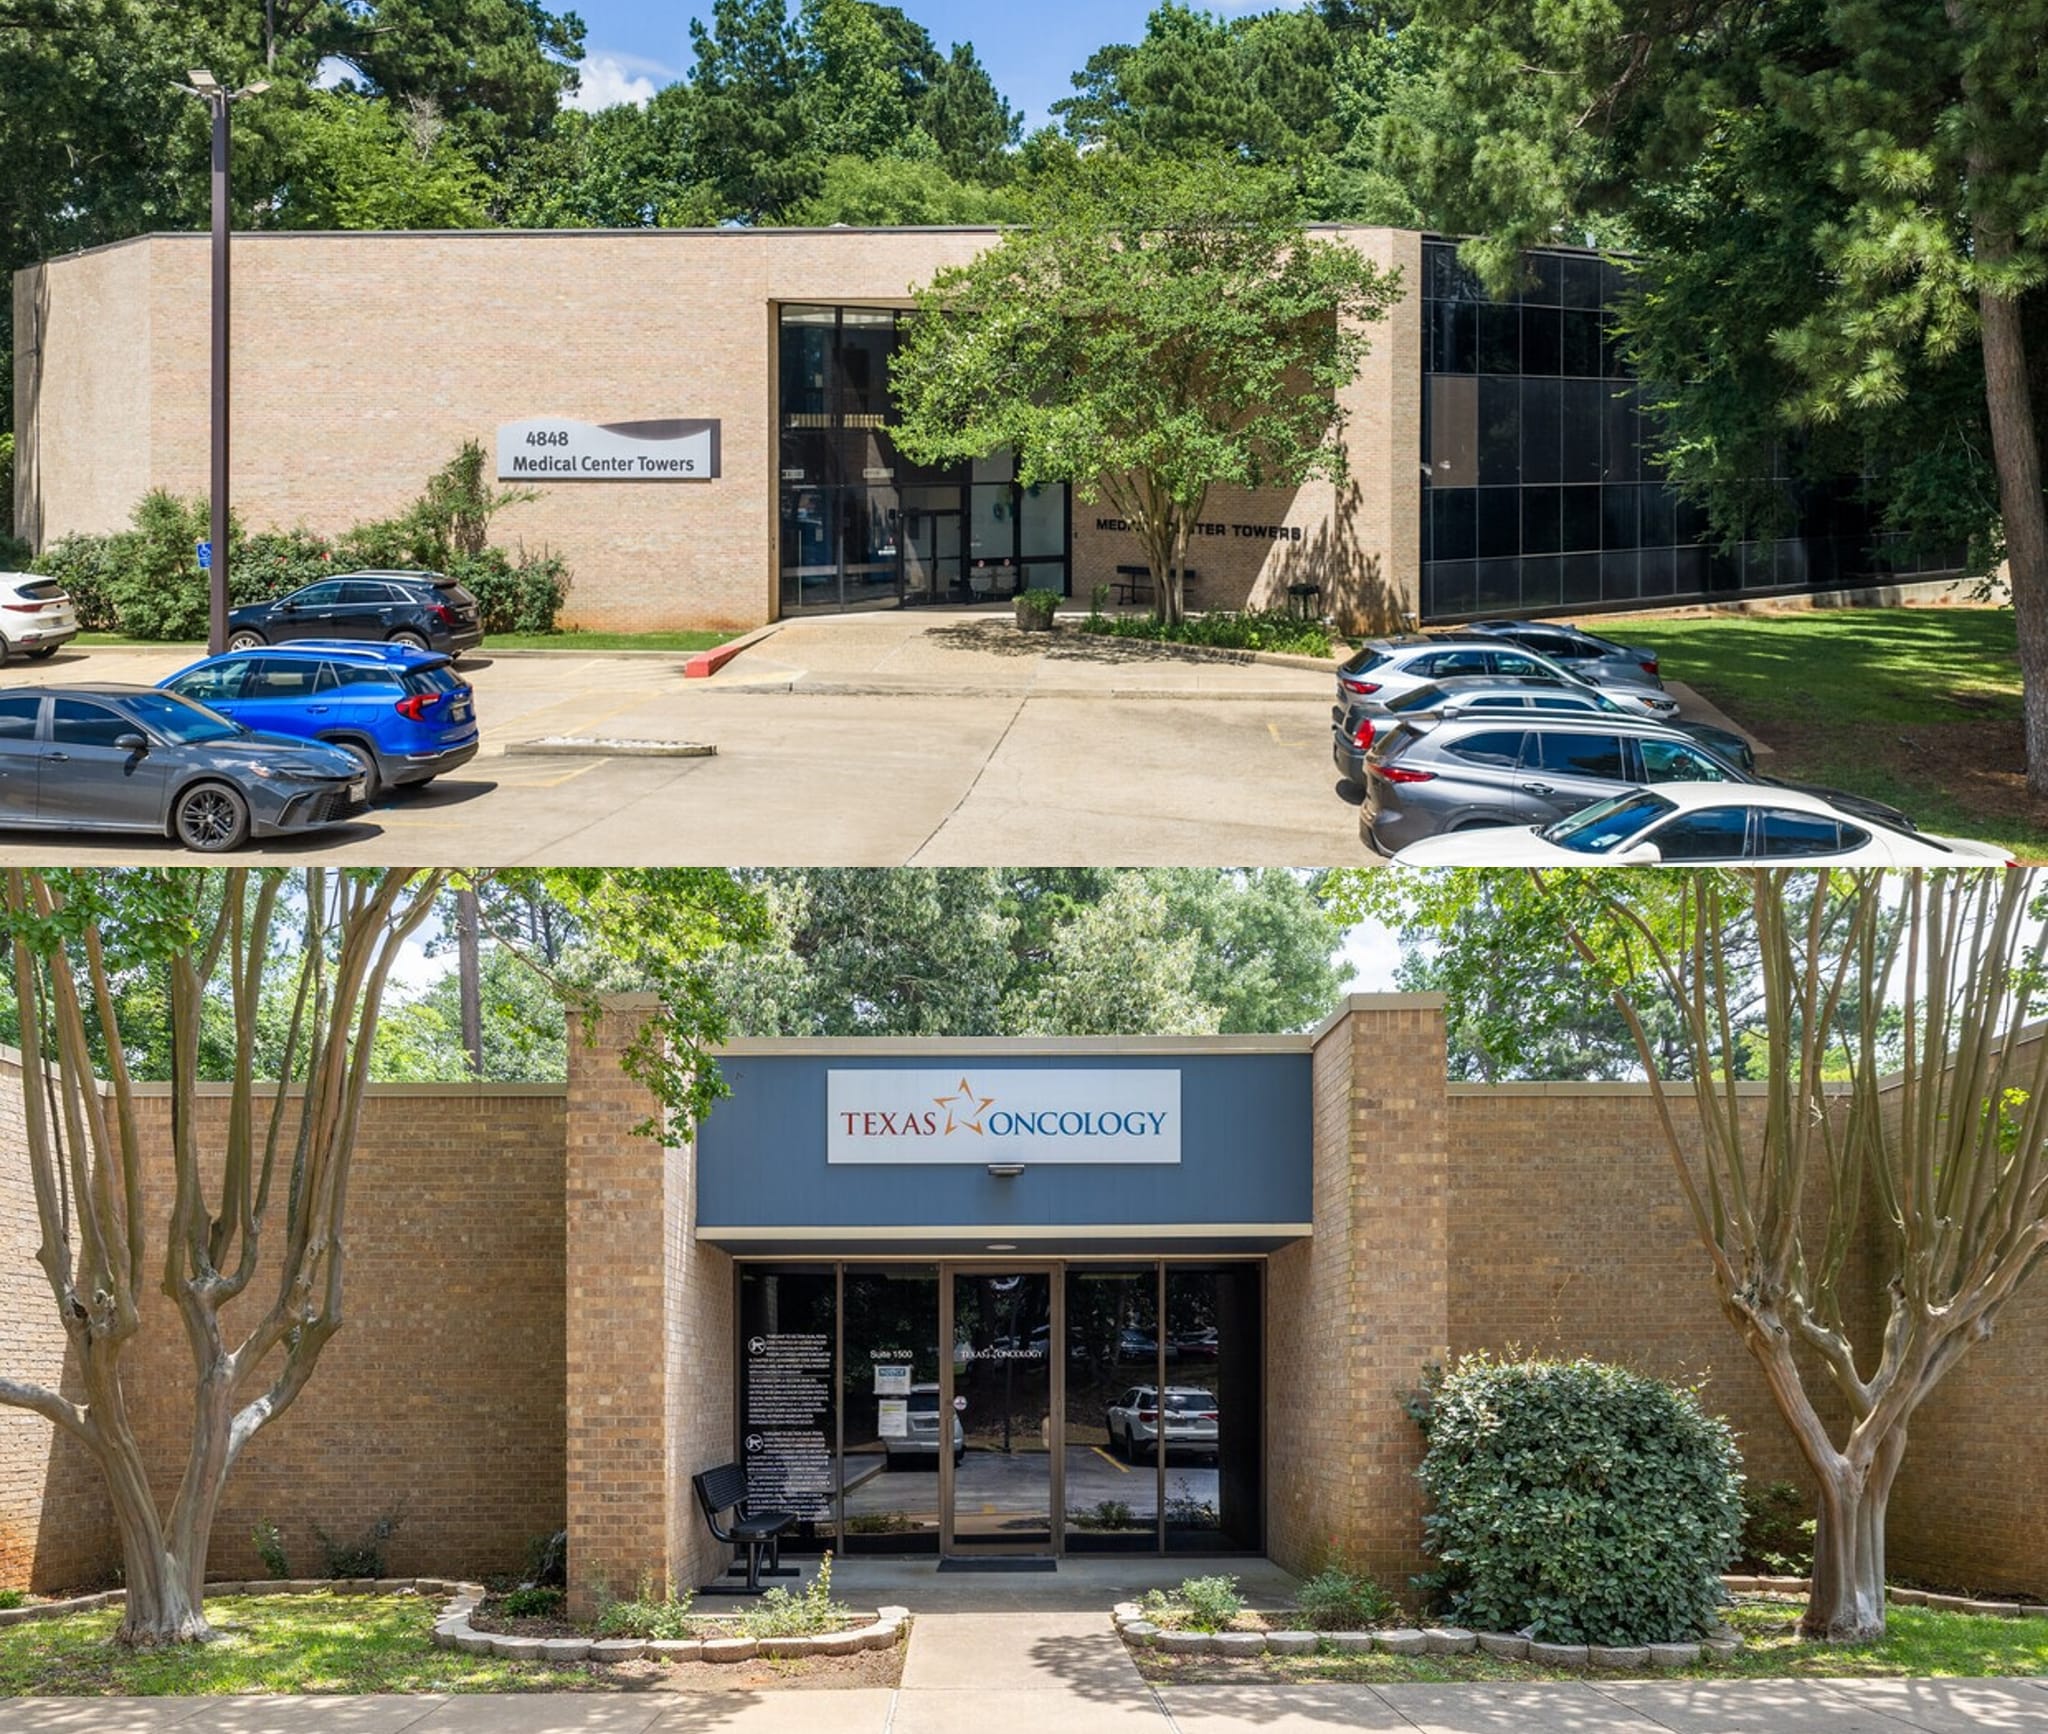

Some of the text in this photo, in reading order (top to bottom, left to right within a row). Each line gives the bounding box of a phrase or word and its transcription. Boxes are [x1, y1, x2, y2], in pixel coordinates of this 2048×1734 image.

[526, 431, 568, 446] 4848
[513, 456, 694, 472] Medical Center Towers
[1232, 524, 1301, 541] TOWERS
[840, 1111, 1167, 1136] TEXAS ONCOLOGY
[870, 1350, 913, 1359] Suite 1500
[997, 1350, 1042, 1359] ONCOLOGY
